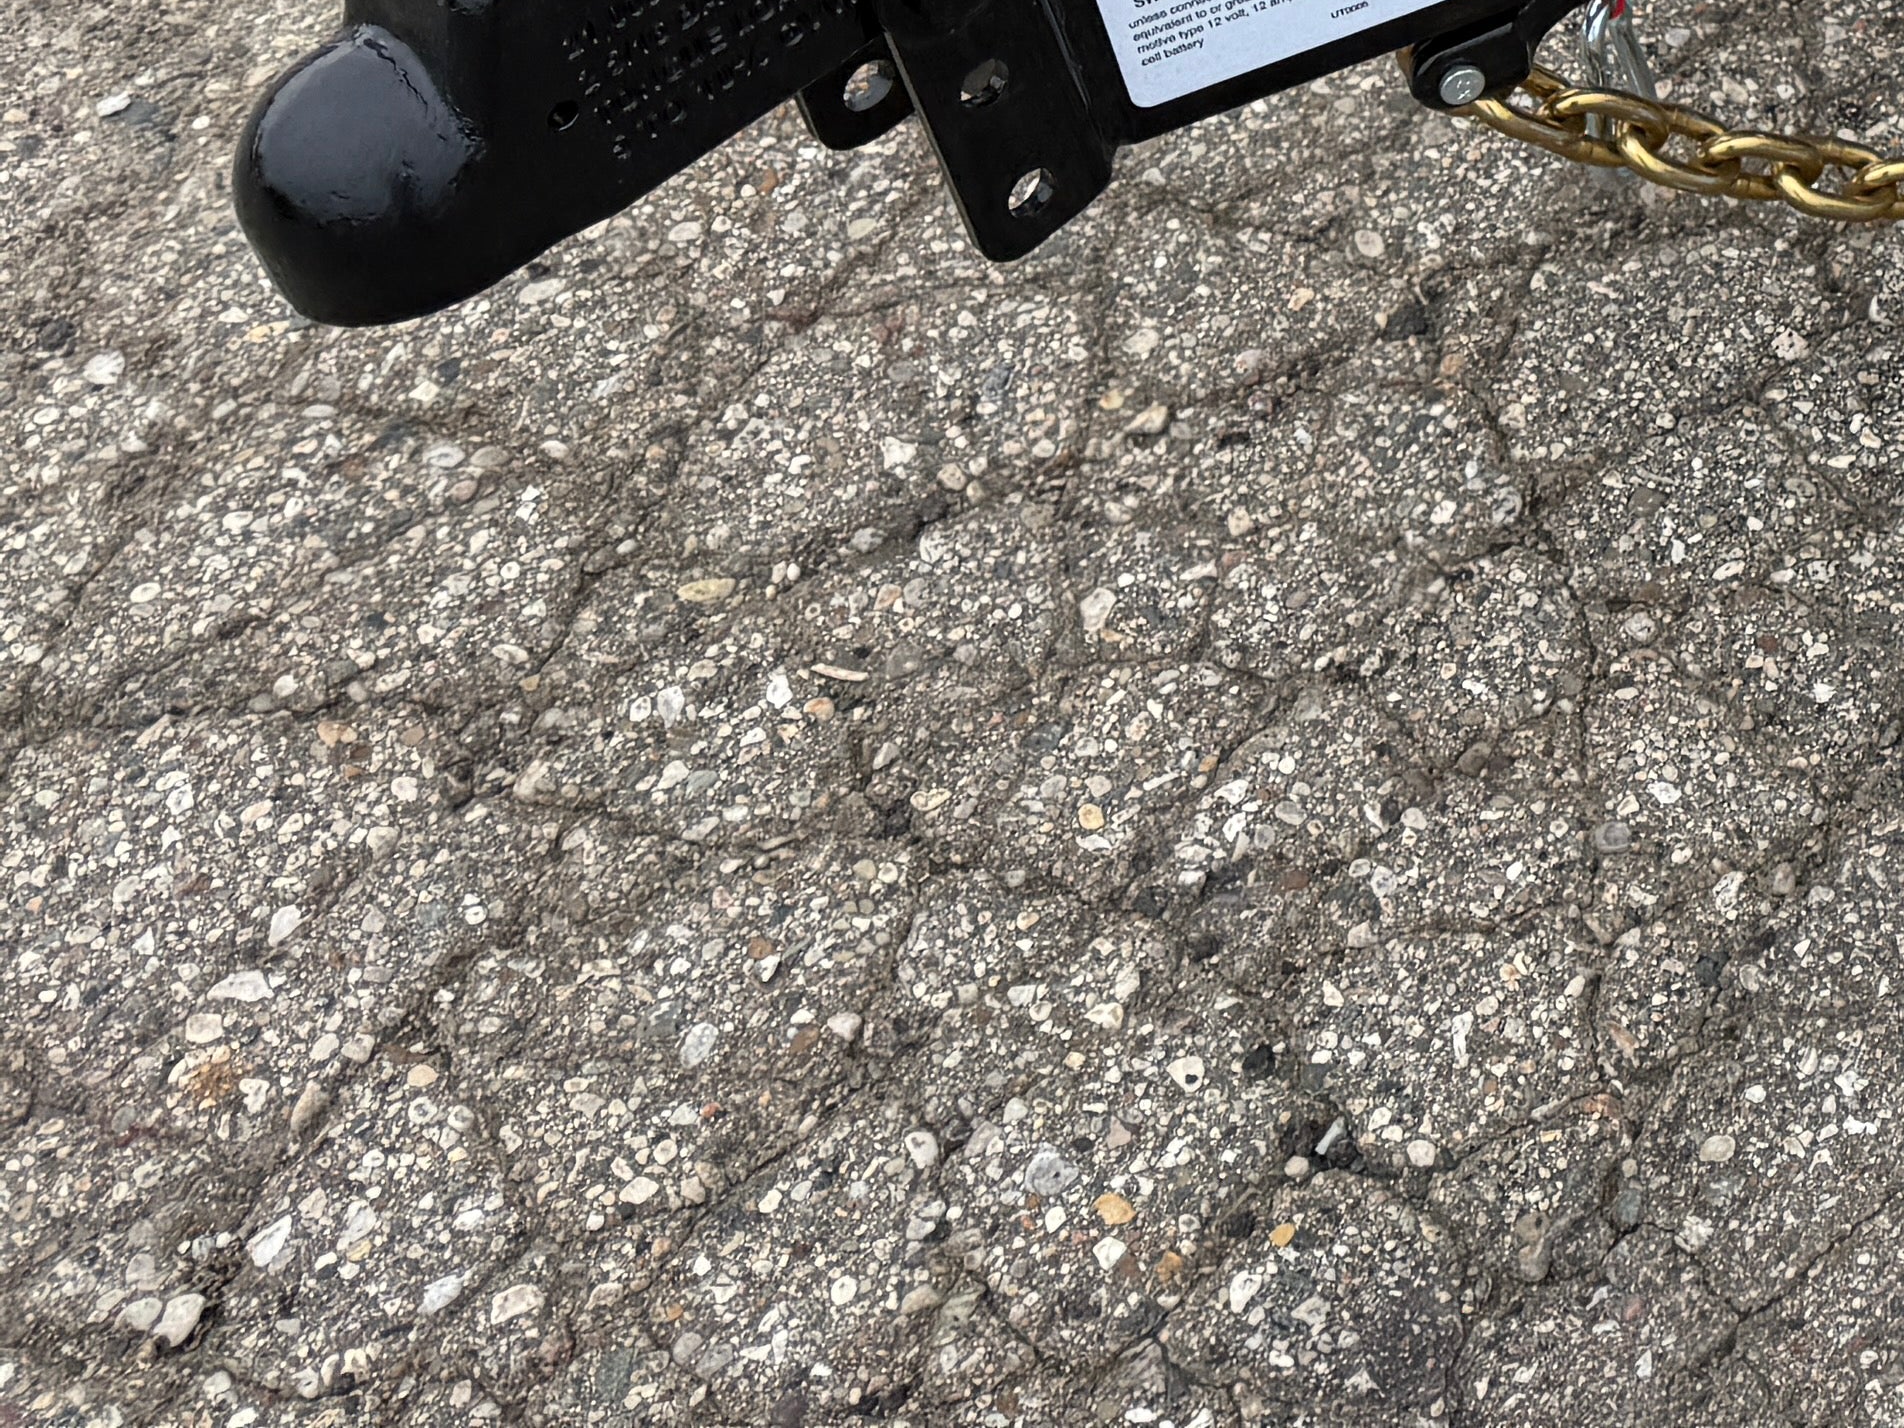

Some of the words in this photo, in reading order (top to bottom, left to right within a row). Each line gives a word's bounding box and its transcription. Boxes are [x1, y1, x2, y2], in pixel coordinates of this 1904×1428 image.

[1194, 8, 1207, 19] to
[1208, 3, 1222, 14] or
[1206, 15, 1222, 29] 12
[1252, 0, 1266, 12] 12
